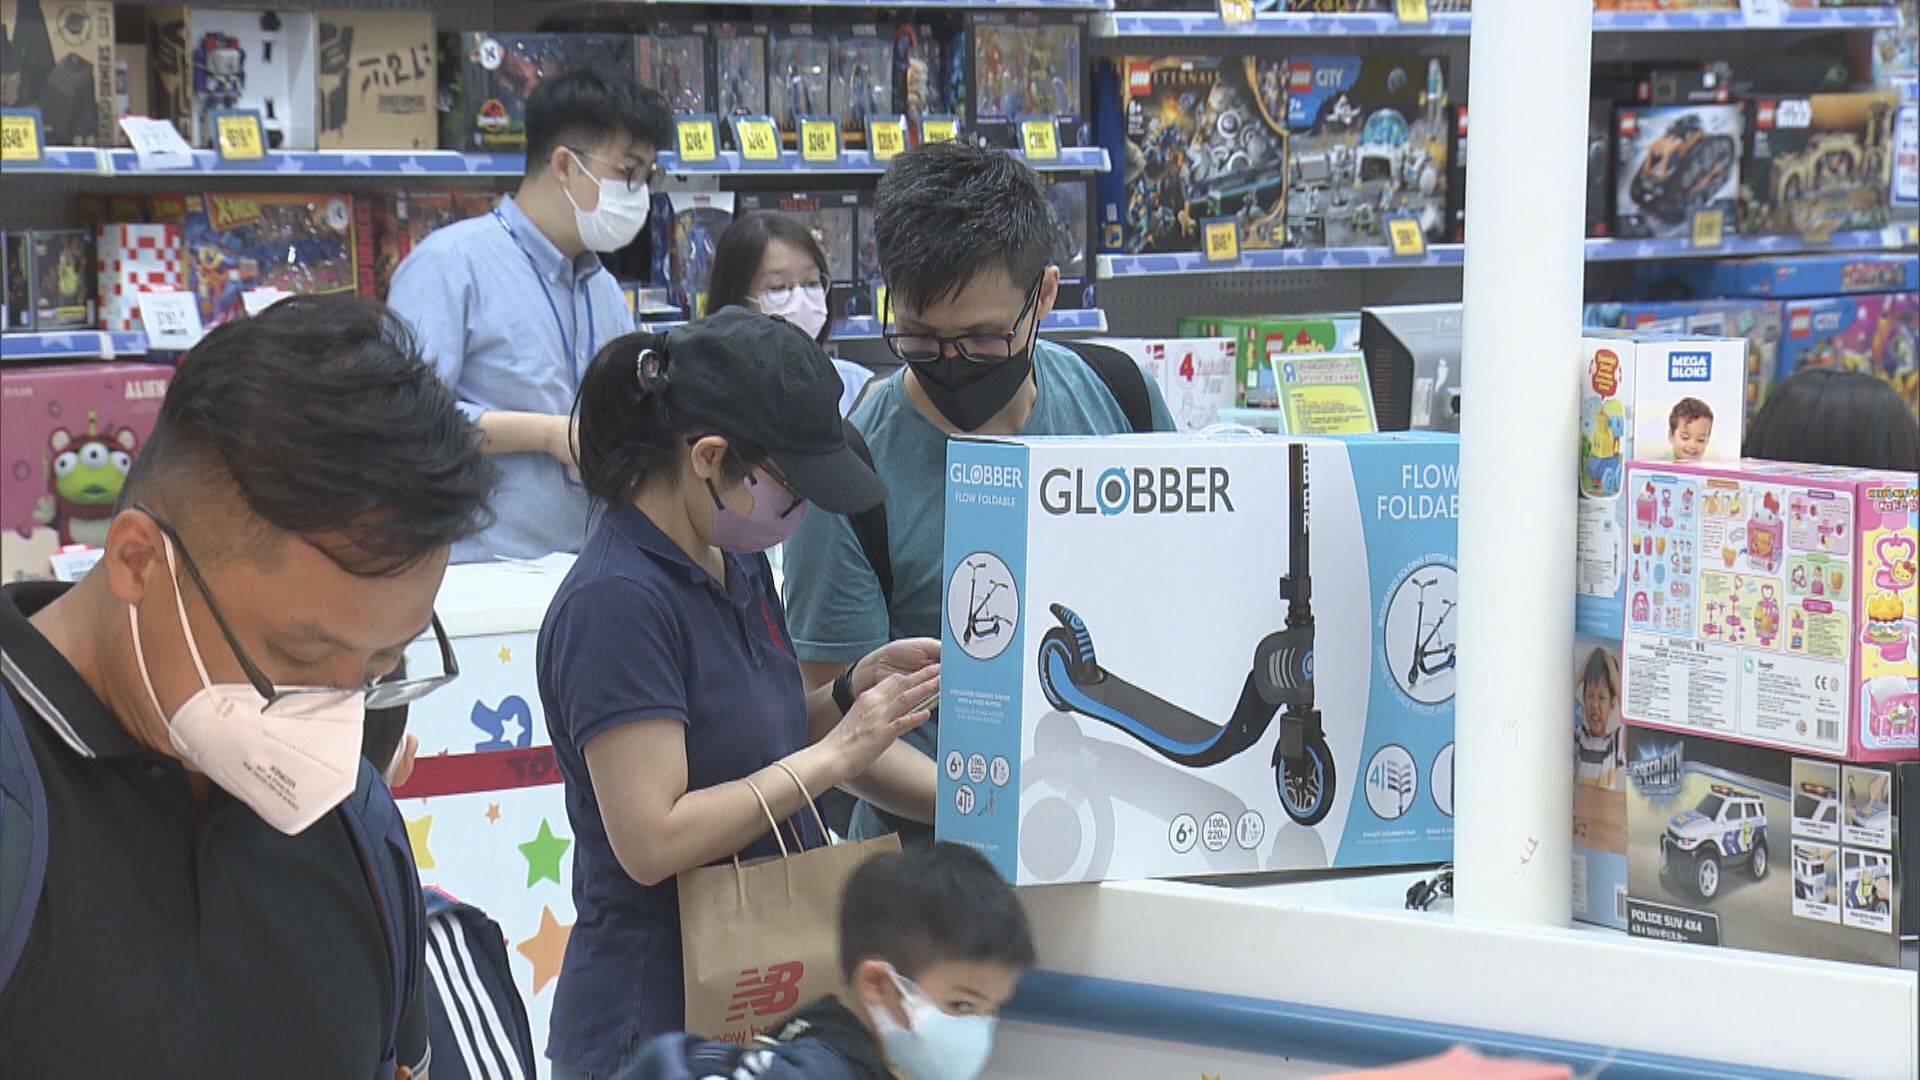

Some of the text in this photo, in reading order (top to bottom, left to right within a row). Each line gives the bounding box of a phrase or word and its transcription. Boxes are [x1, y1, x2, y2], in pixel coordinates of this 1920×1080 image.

[1315, 68, 1344, 88] CITY
[1671, 356, 1708, 367] MEGA
[1671, 368, 1708, 379] BLOKS
[950, 463, 1023, 488] GLOBBER
[1402, 464, 1459, 488] FLOW
[955, 492, 1016, 507] FLOW FOLDABLE
[1039, 467, 1235, 516] GLOBBER
[1176, 823, 1194, 844] 6+
[1631, 909, 1703, 933] POLICE SUV 4X4
